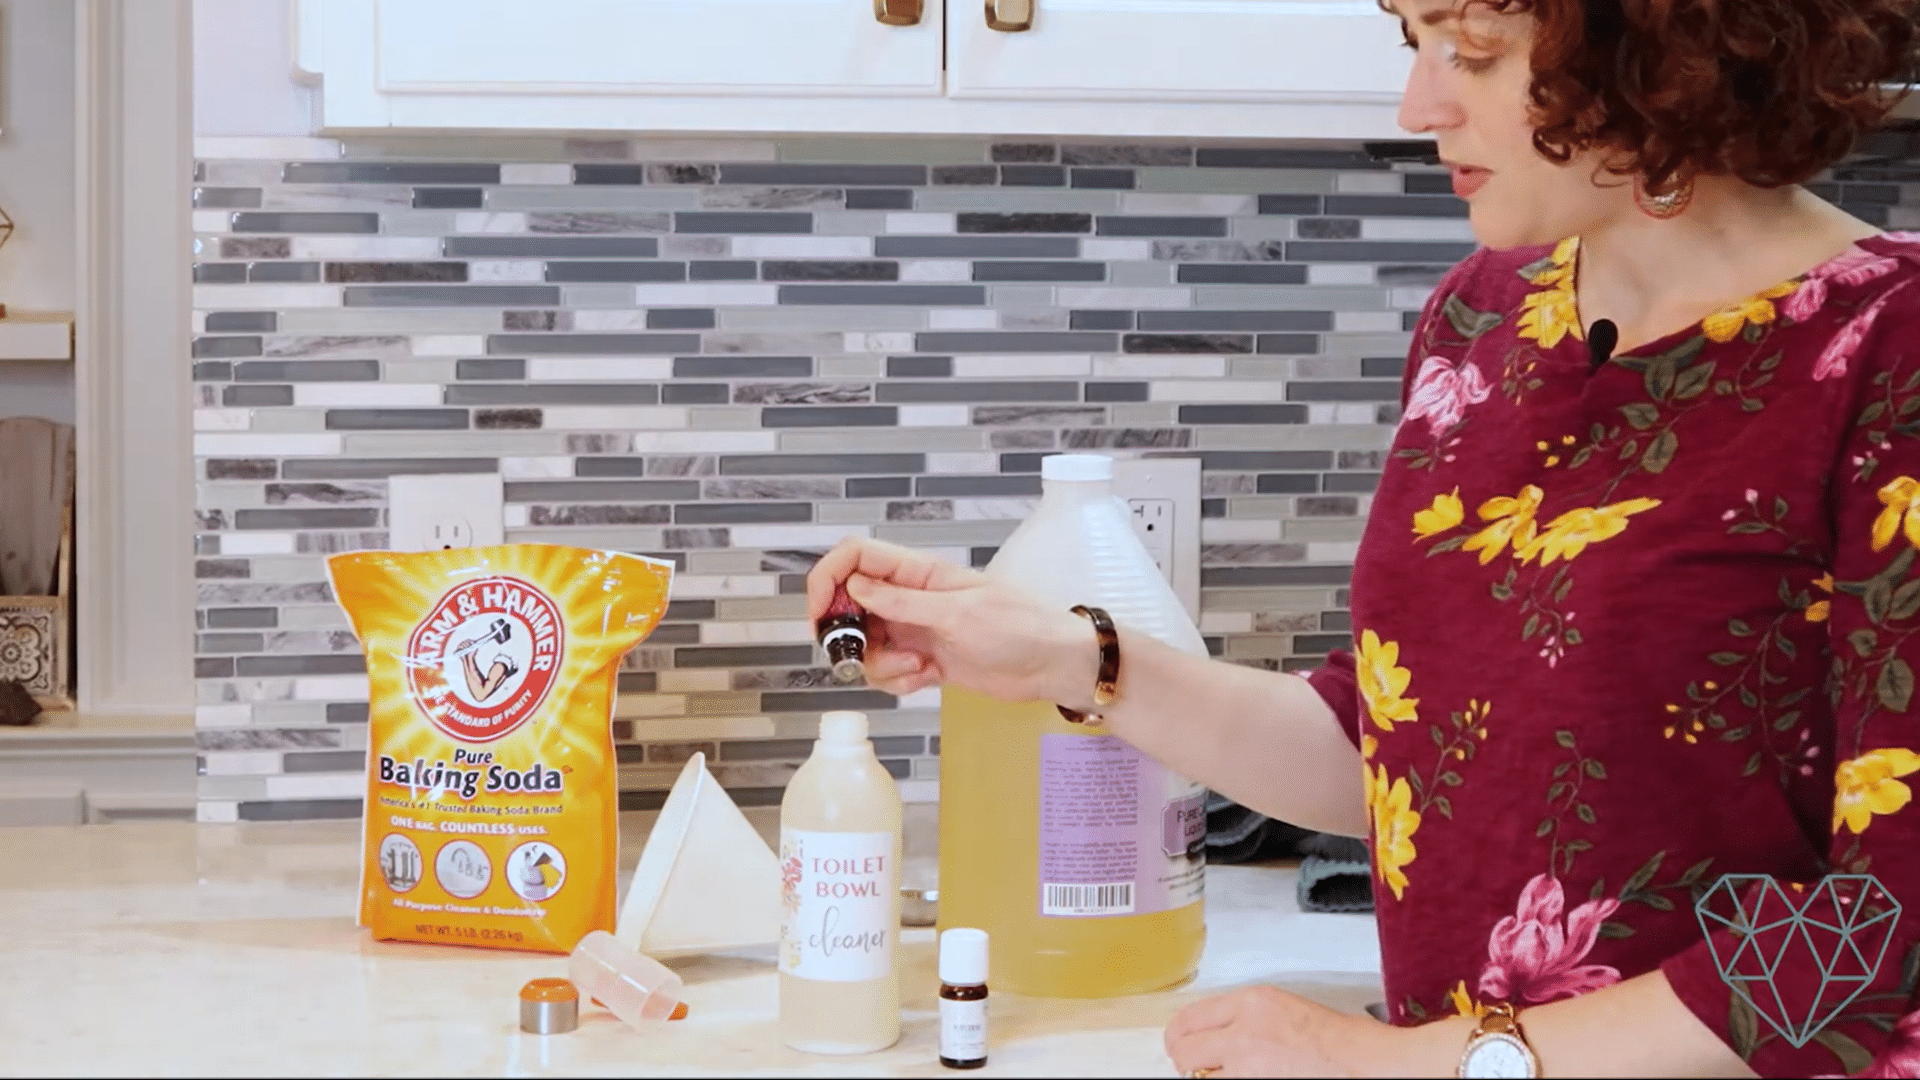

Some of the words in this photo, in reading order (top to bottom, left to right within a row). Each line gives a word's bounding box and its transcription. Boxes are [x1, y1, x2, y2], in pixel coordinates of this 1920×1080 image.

[416, 607, 459, 668] ARM
[457, 594, 479, 617] &
[482, 585, 557, 671] HAMMER
[503, 689, 532, 719] PURITY
[454, 749, 492, 763] Pure
[380, 757, 479, 797] Baking
[487, 764, 561, 789] Soda
[469, 804, 502, 816] Baking
[506, 806, 529, 814] Soda
[533, 805, 563, 814] Brand
[391, 815, 413, 827] ONE
[440, 821, 515, 834] COUNTLESS
[811, 856, 886, 875] TOILET
[816, 881, 881, 898] BOWL
[415, 924, 434, 935] NET
[809, 905, 887, 957] cleaner
